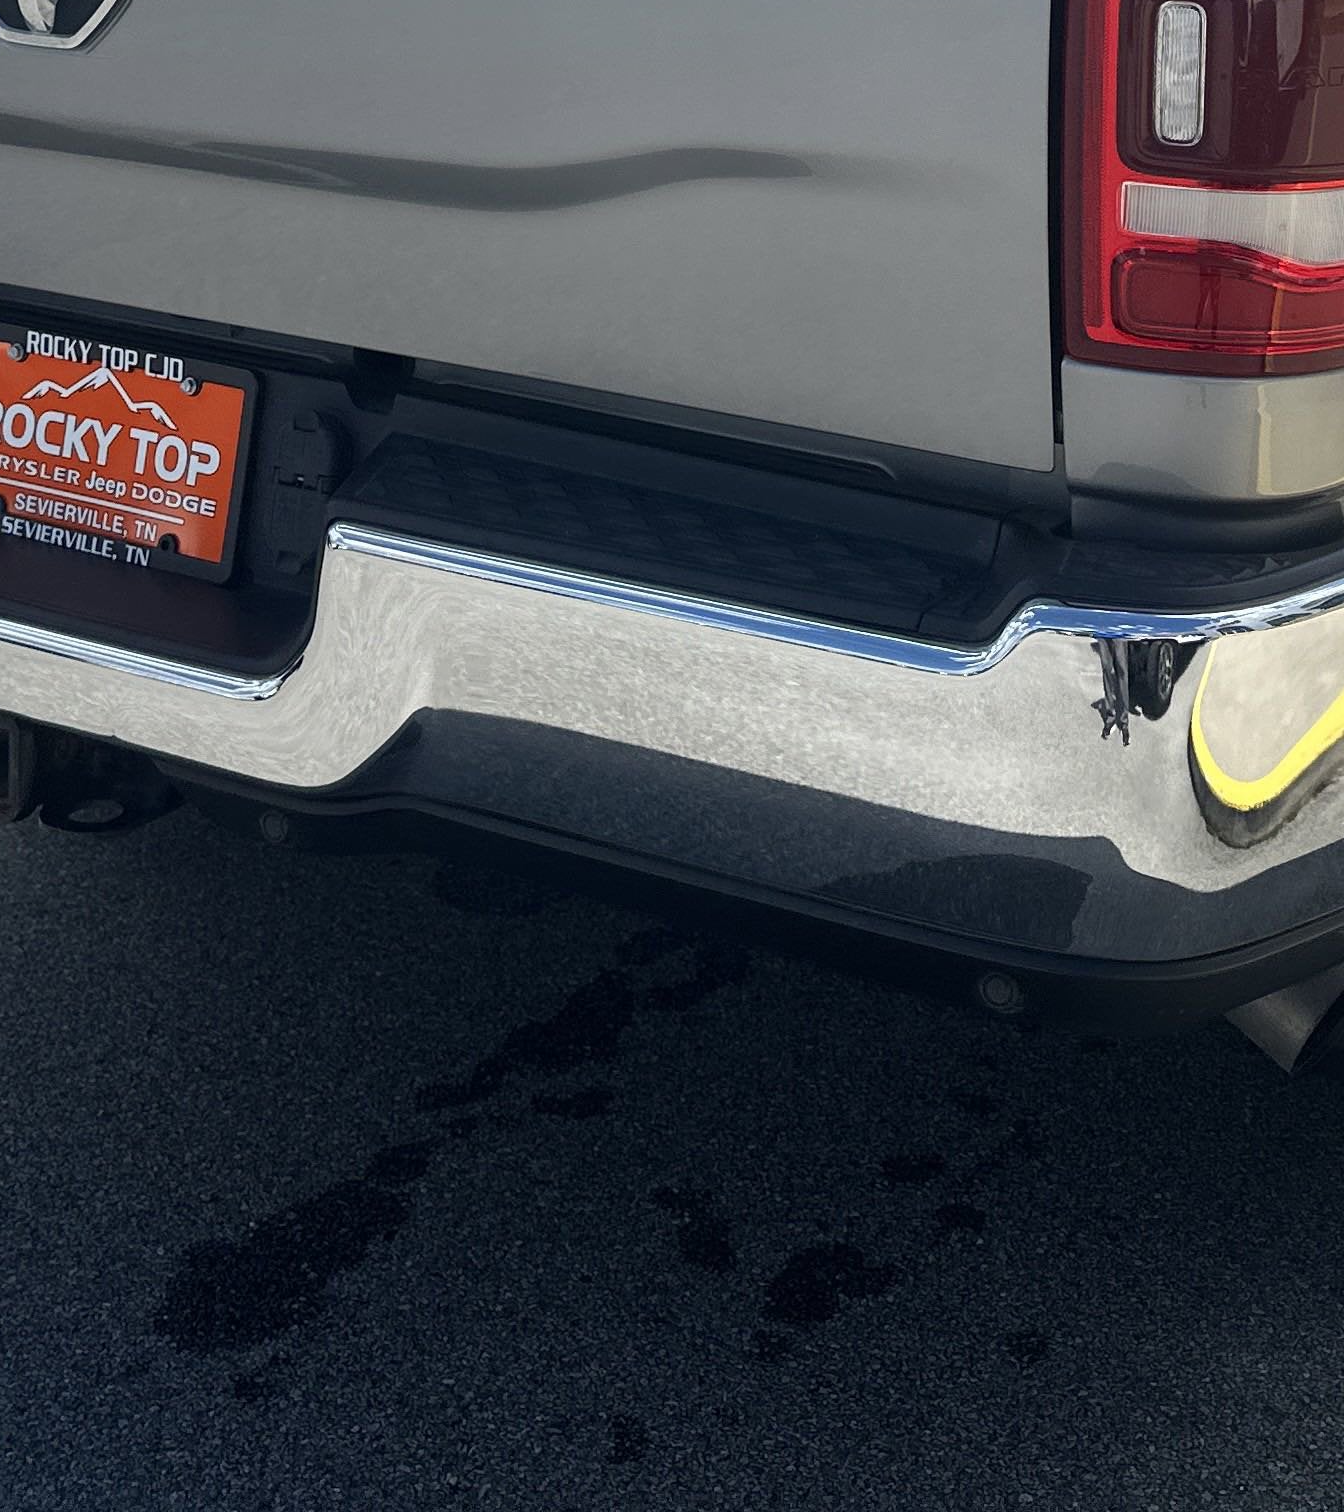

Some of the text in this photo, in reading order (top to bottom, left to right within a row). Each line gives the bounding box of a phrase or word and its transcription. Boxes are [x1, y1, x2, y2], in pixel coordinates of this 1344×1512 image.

[26, 330, 184, 382] ROCKY TOP CJD
[129, 428, 221, 487] TOP
[14, 493, 159, 542] SEVIERVILLE, TN
[85, 471, 126, 498] Jeep
[131, 482, 217, 517] DODGE
[1, 516, 151, 567] SEVIERVILLE, TN
